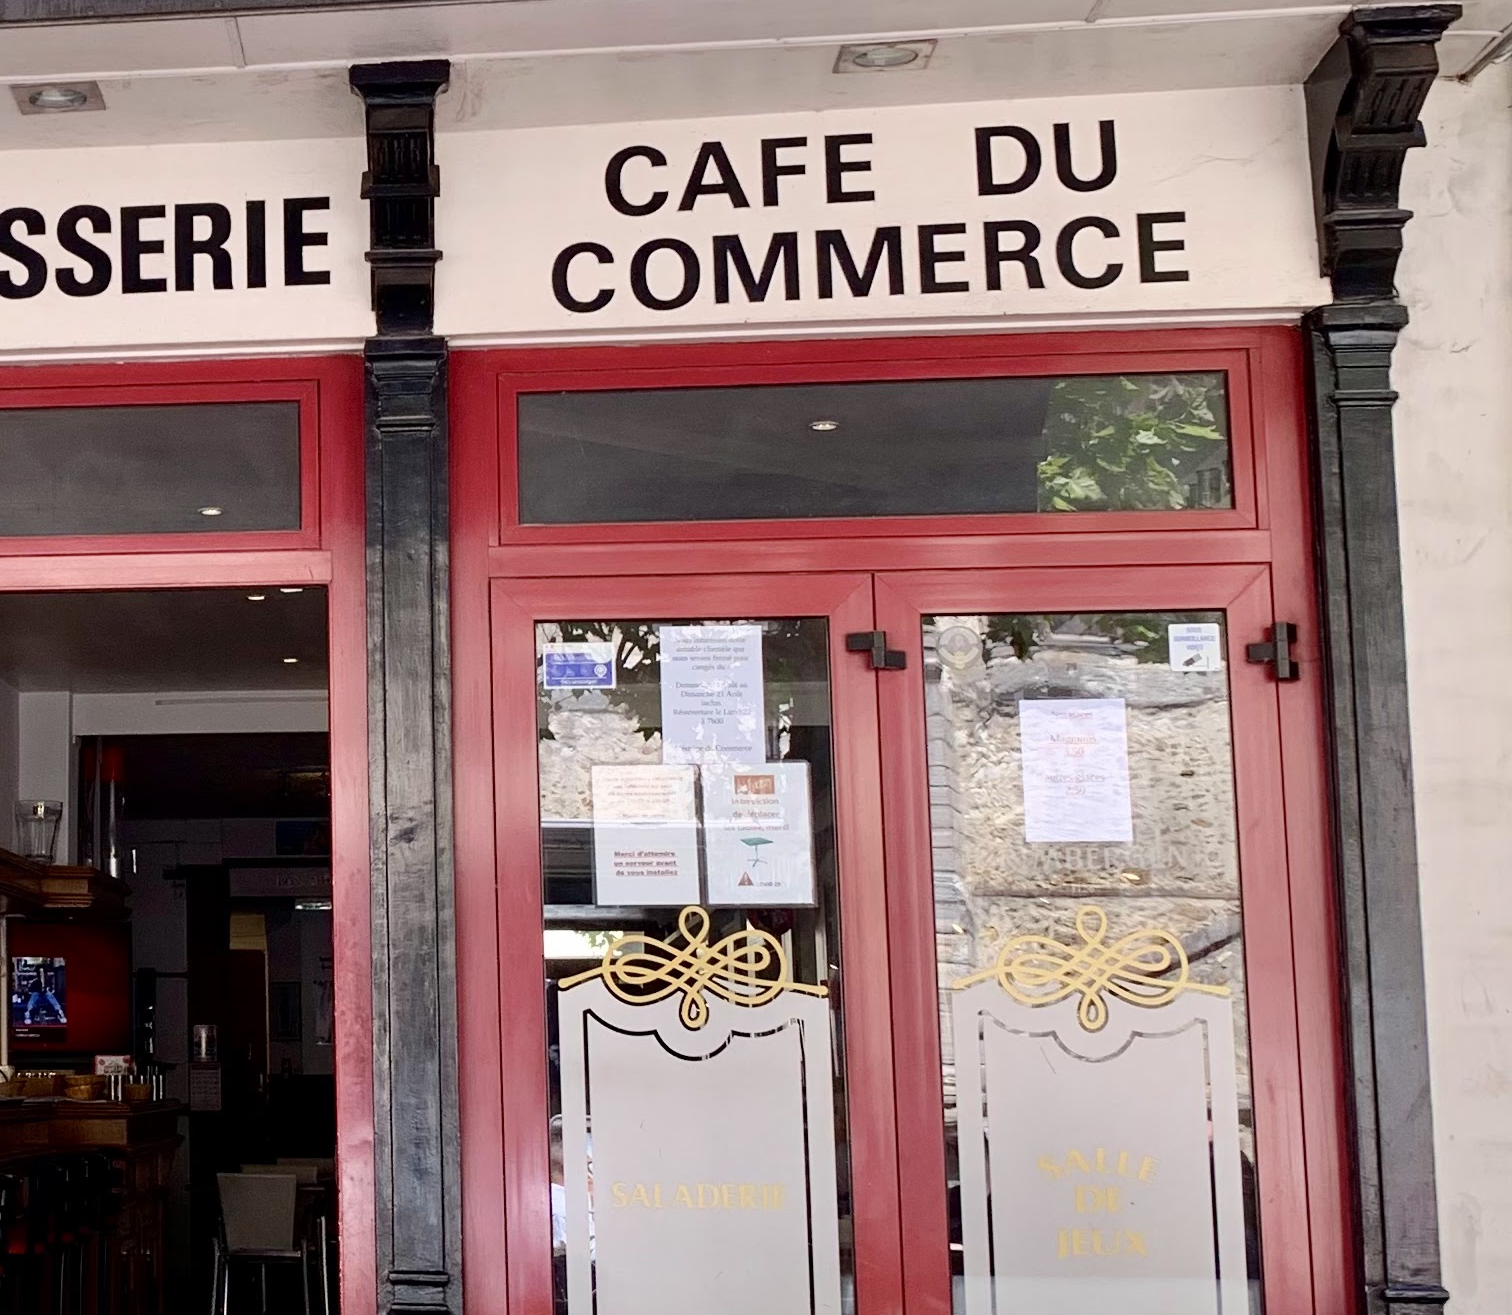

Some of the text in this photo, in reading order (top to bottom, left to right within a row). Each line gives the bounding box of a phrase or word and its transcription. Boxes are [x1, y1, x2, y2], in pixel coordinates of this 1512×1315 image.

[603, 118, 1116, 217] CAFE DU
[550, 210, 1189, 313] COMMERCE
[1036, 1146, 1163, 1185] SALLE
[1073, 1184, 1124, 1214] DE
[1055, 1227, 1150, 1259] JEUX
